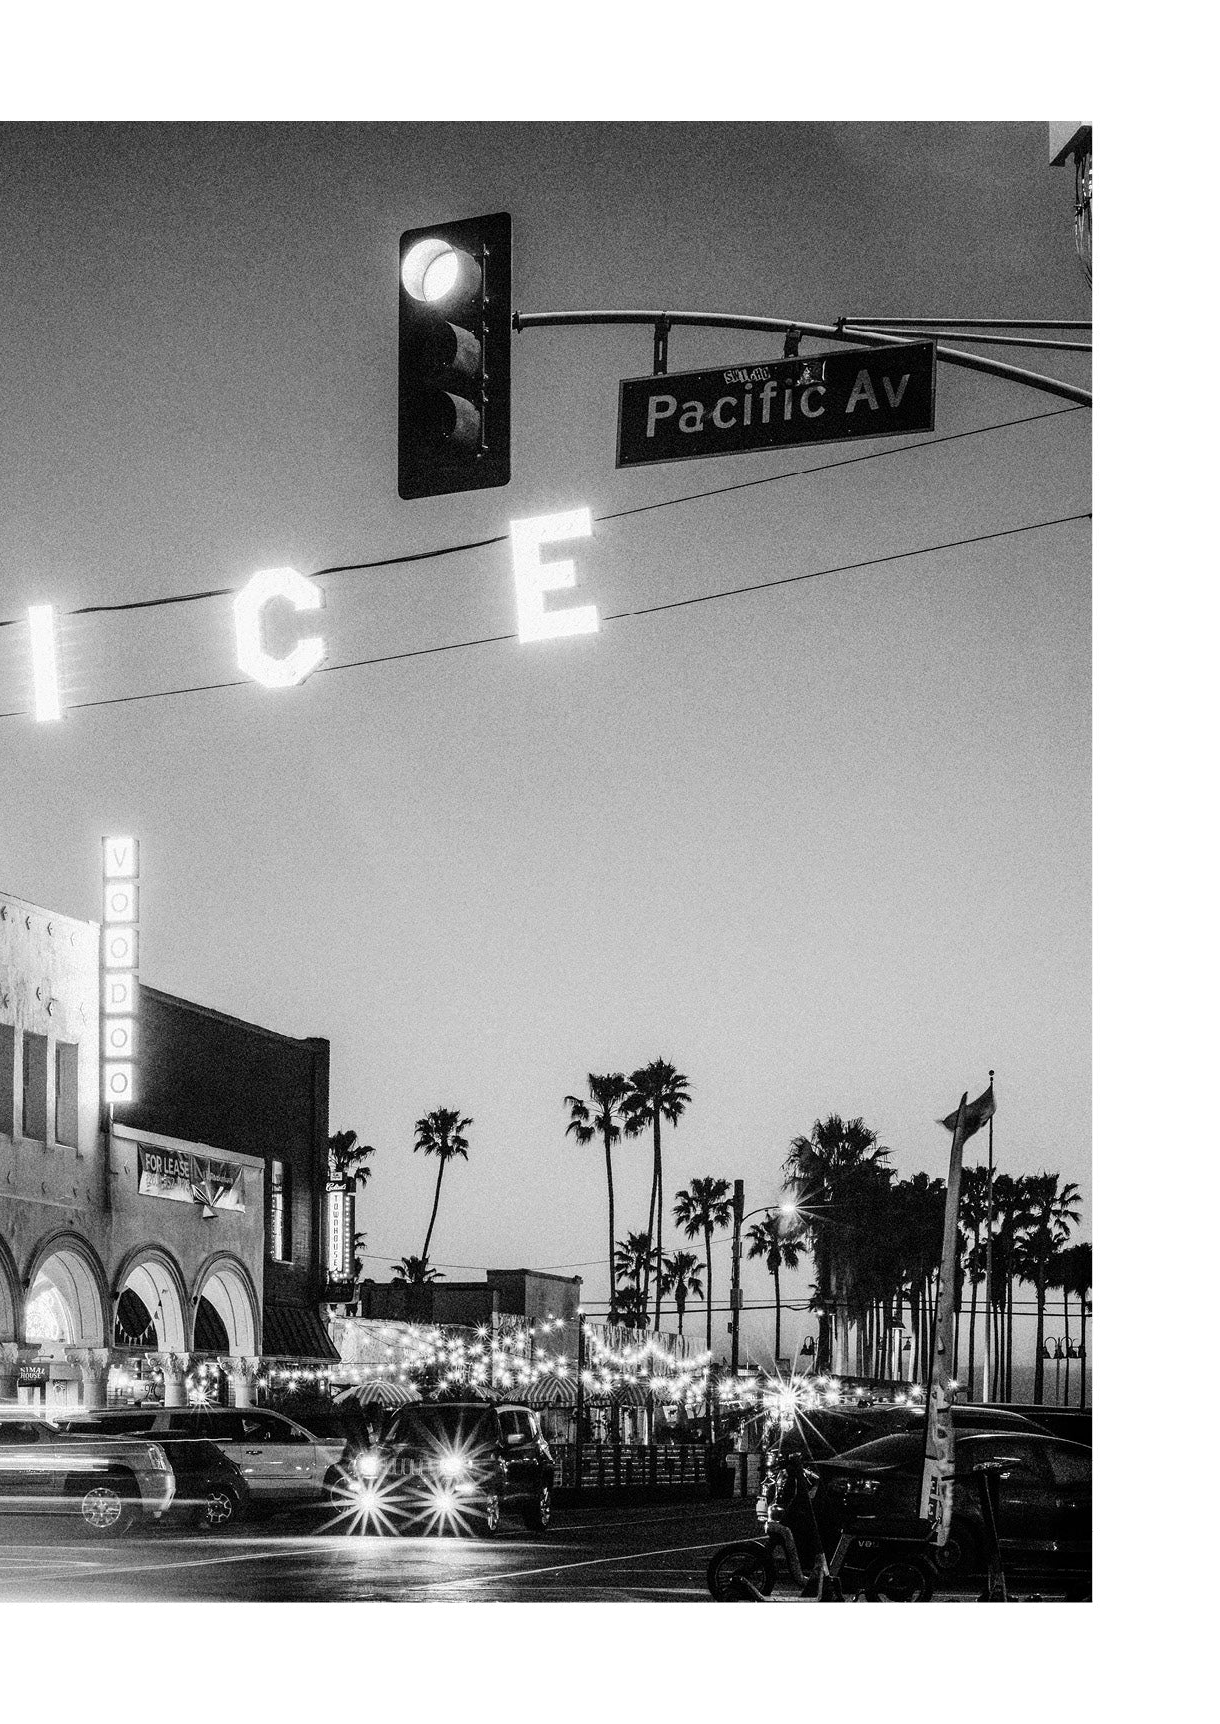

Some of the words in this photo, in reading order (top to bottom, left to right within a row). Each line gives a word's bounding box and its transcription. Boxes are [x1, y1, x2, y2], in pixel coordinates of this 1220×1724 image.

[645, 377, 827, 438] Pacific
[845, 368, 911, 414] Av
[109, 846, 130, 1095] VOODOO
[145, 1153, 162, 1173] FOR
[164, 1157, 190, 1178] LEASE
[20, 1366, 45, 1375] NIMAL
